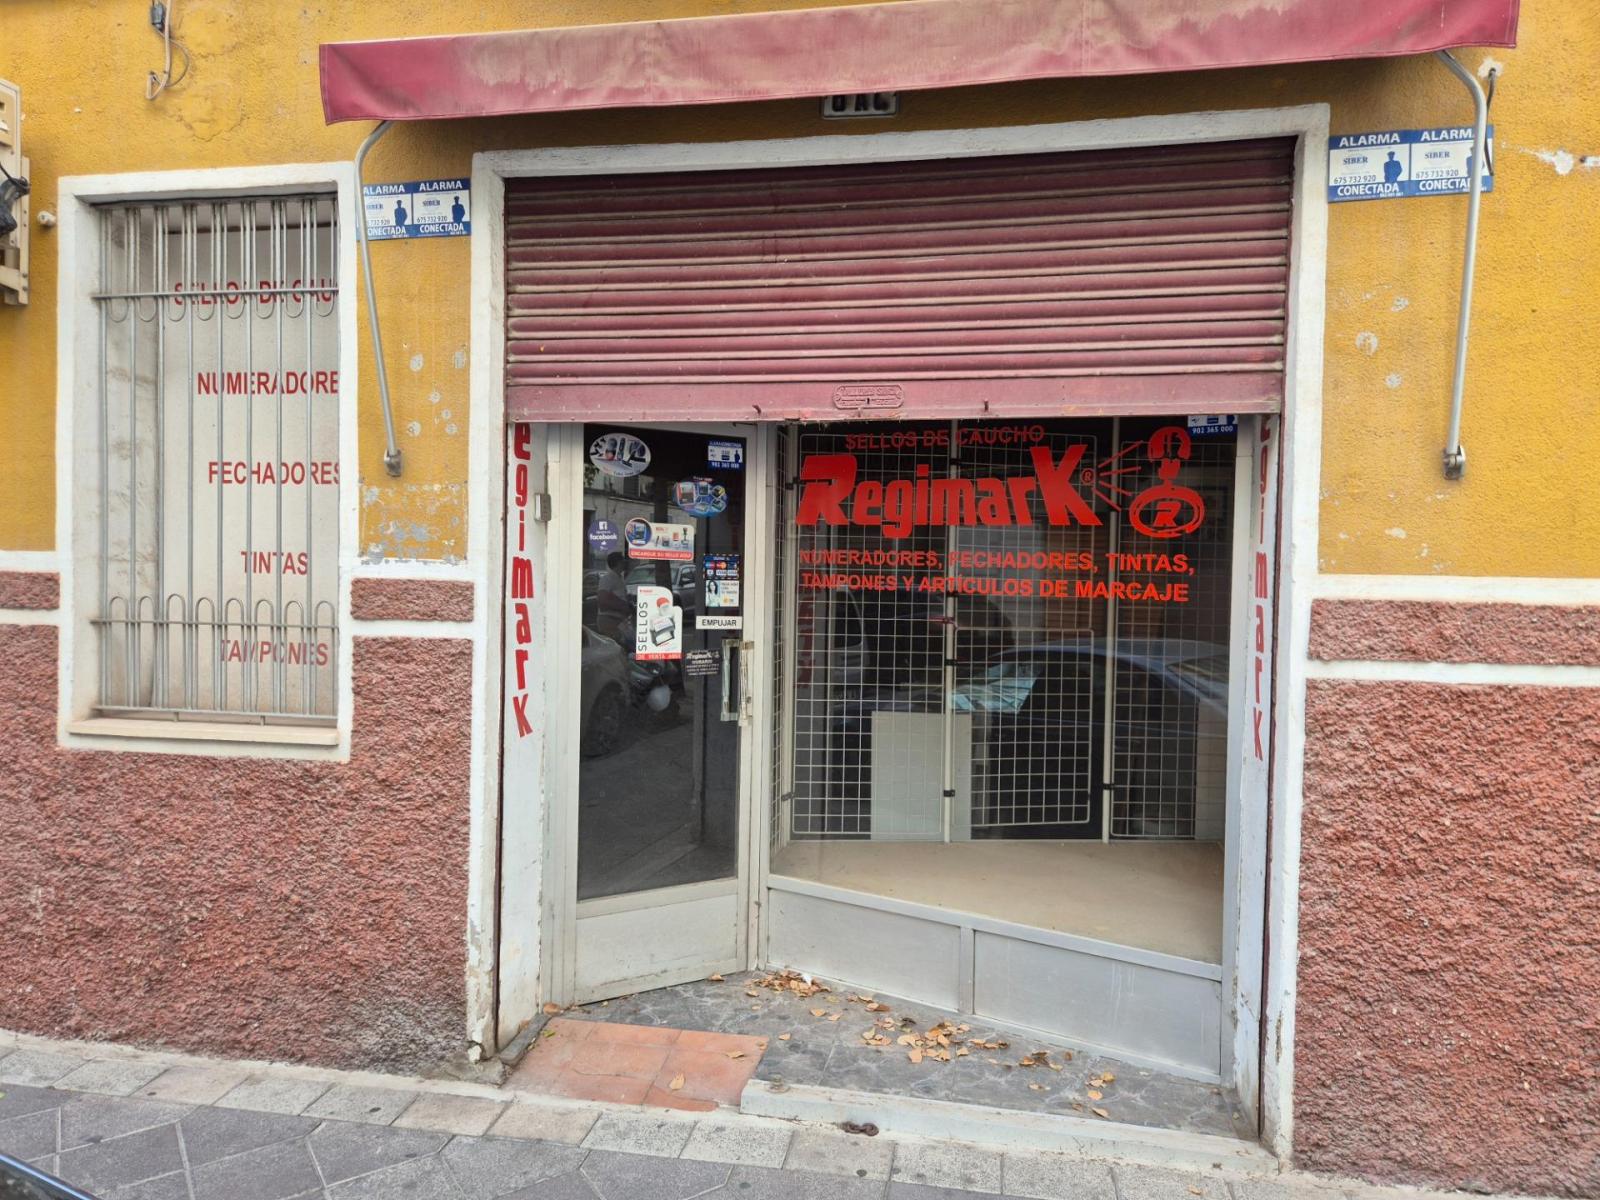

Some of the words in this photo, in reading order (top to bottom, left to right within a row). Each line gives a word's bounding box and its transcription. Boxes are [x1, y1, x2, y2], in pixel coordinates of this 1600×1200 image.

[1339, 133, 1400, 147] ALARMA
[1420, 129, 1474, 141] ALARM
[363, 184, 405, 195] ALARMA
[419, 180, 463, 192] ALARMA
[1337, 183, 1400, 196] CONECTADA
[1419, 178, 1471, 191] CONECTA
[367, 226, 407, 236] ONECTADA
[419, 222, 464, 234] CONECTADA
[174, 280, 247, 306] SLLO
[292, 278, 339, 304] CAU
[846, 431, 917, 450] SELLOS
[923, 429, 949, 447] DE
[956, 425, 1045, 445] CAUCHO
[800, 549, 943, 570] NUMERADORES,
[950, 551, 1098, 573] FECHADORES,
[1105, 552, 1195, 576] TINTAS,
[802, 572, 897, 591] TAMPONES
[903, 576, 914, 592] Y
[918, 573, 1034, 596] ARTÍCULOS
[1039, 580, 1068, 598] DE
[1075, 580, 1190, 602] MARCAJE
[637, 601, 648, 652] SELLOS
[701, 619, 737, 627] EMPUJAR
